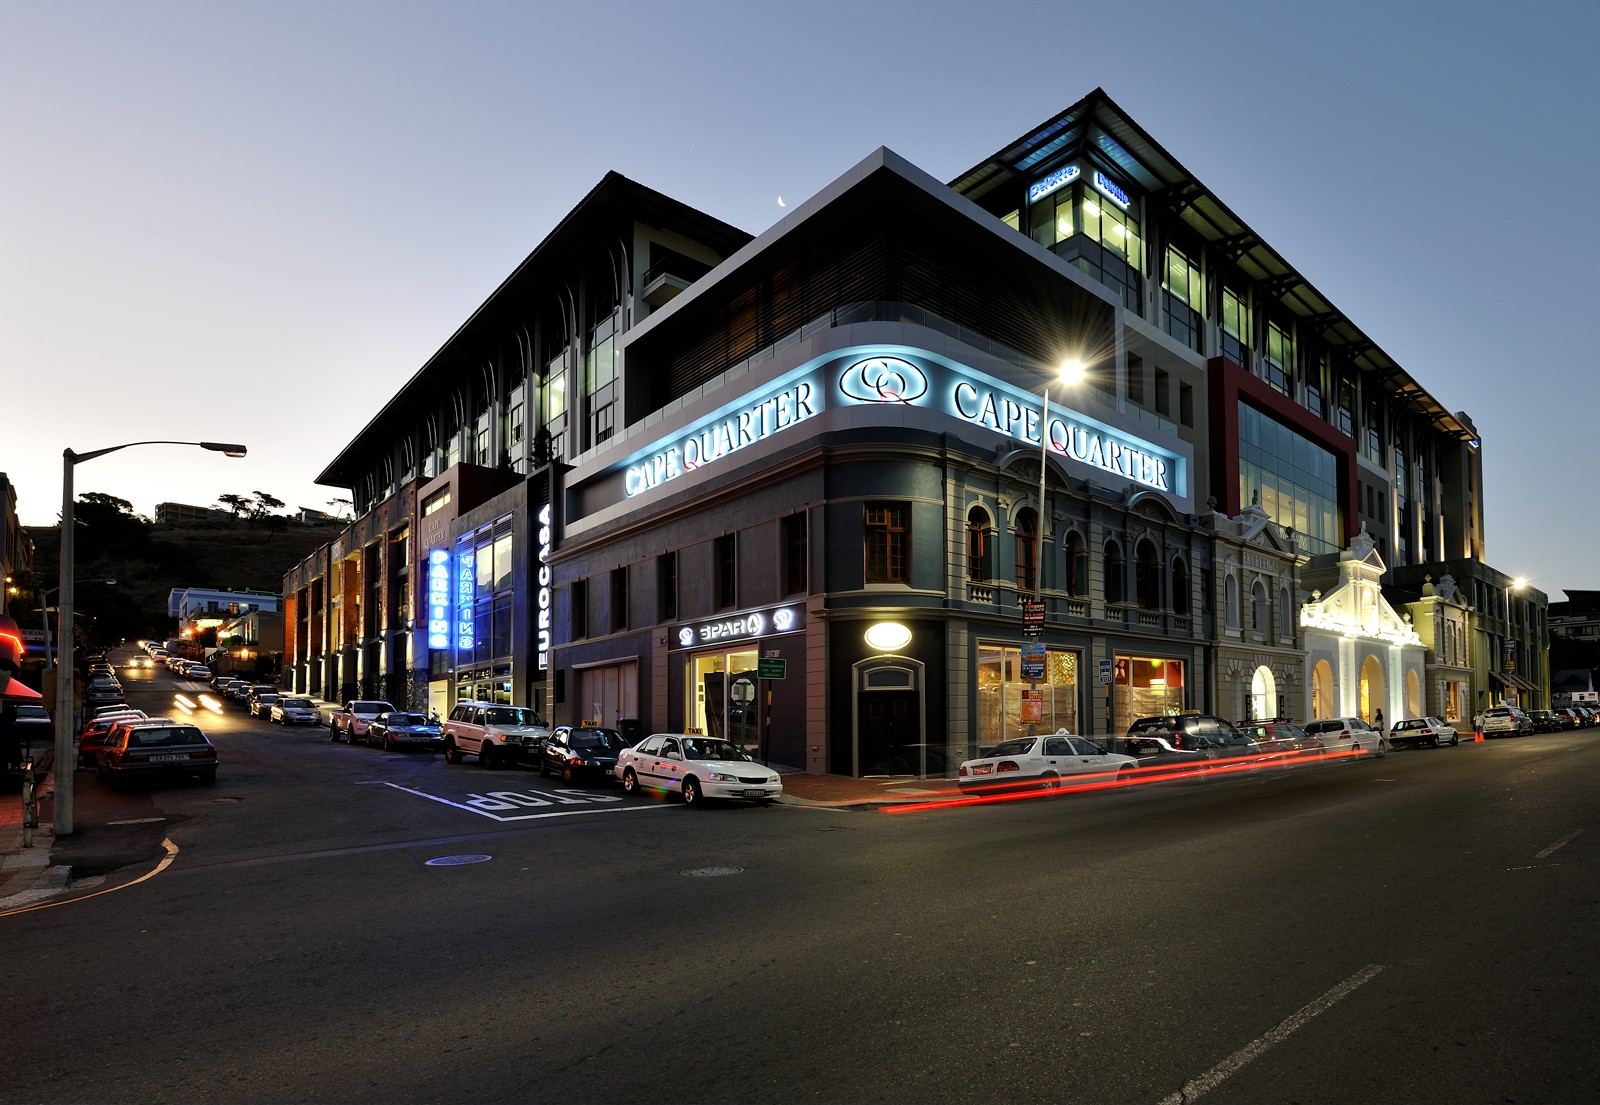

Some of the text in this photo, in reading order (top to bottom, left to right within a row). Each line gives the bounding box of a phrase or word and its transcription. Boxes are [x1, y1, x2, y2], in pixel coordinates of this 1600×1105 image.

[624, 381, 816, 497] CAPE QUARTER
[954, 382, 1169, 490] CAPE QUARTER
[428, 518, 441, 533] CAPE
[431, 549, 449, 648] PARKING
[538, 503, 551, 671] EUROCASA
[700, 619, 746, 640] SPAR
[466, 789, 624, 811] STOP
